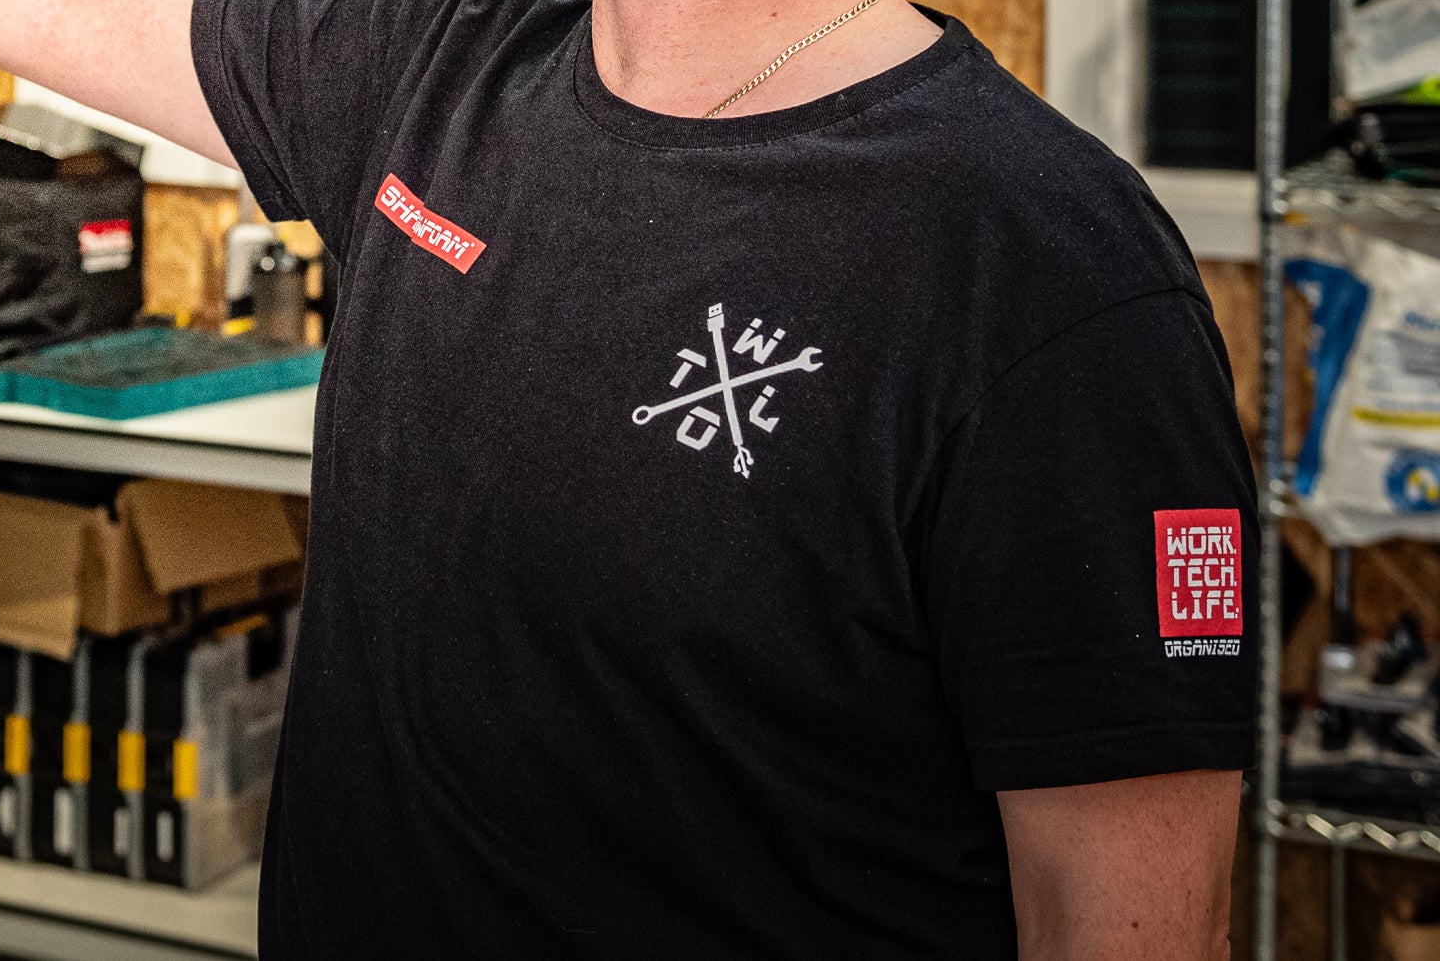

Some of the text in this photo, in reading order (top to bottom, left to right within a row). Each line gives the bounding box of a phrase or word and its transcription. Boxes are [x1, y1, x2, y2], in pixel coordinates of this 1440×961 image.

[1166, 526, 1237, 556] WORK.
[1167, 558, 1237, 588] TECH.
[1164, 639, 1240, 658] ORGANISED
